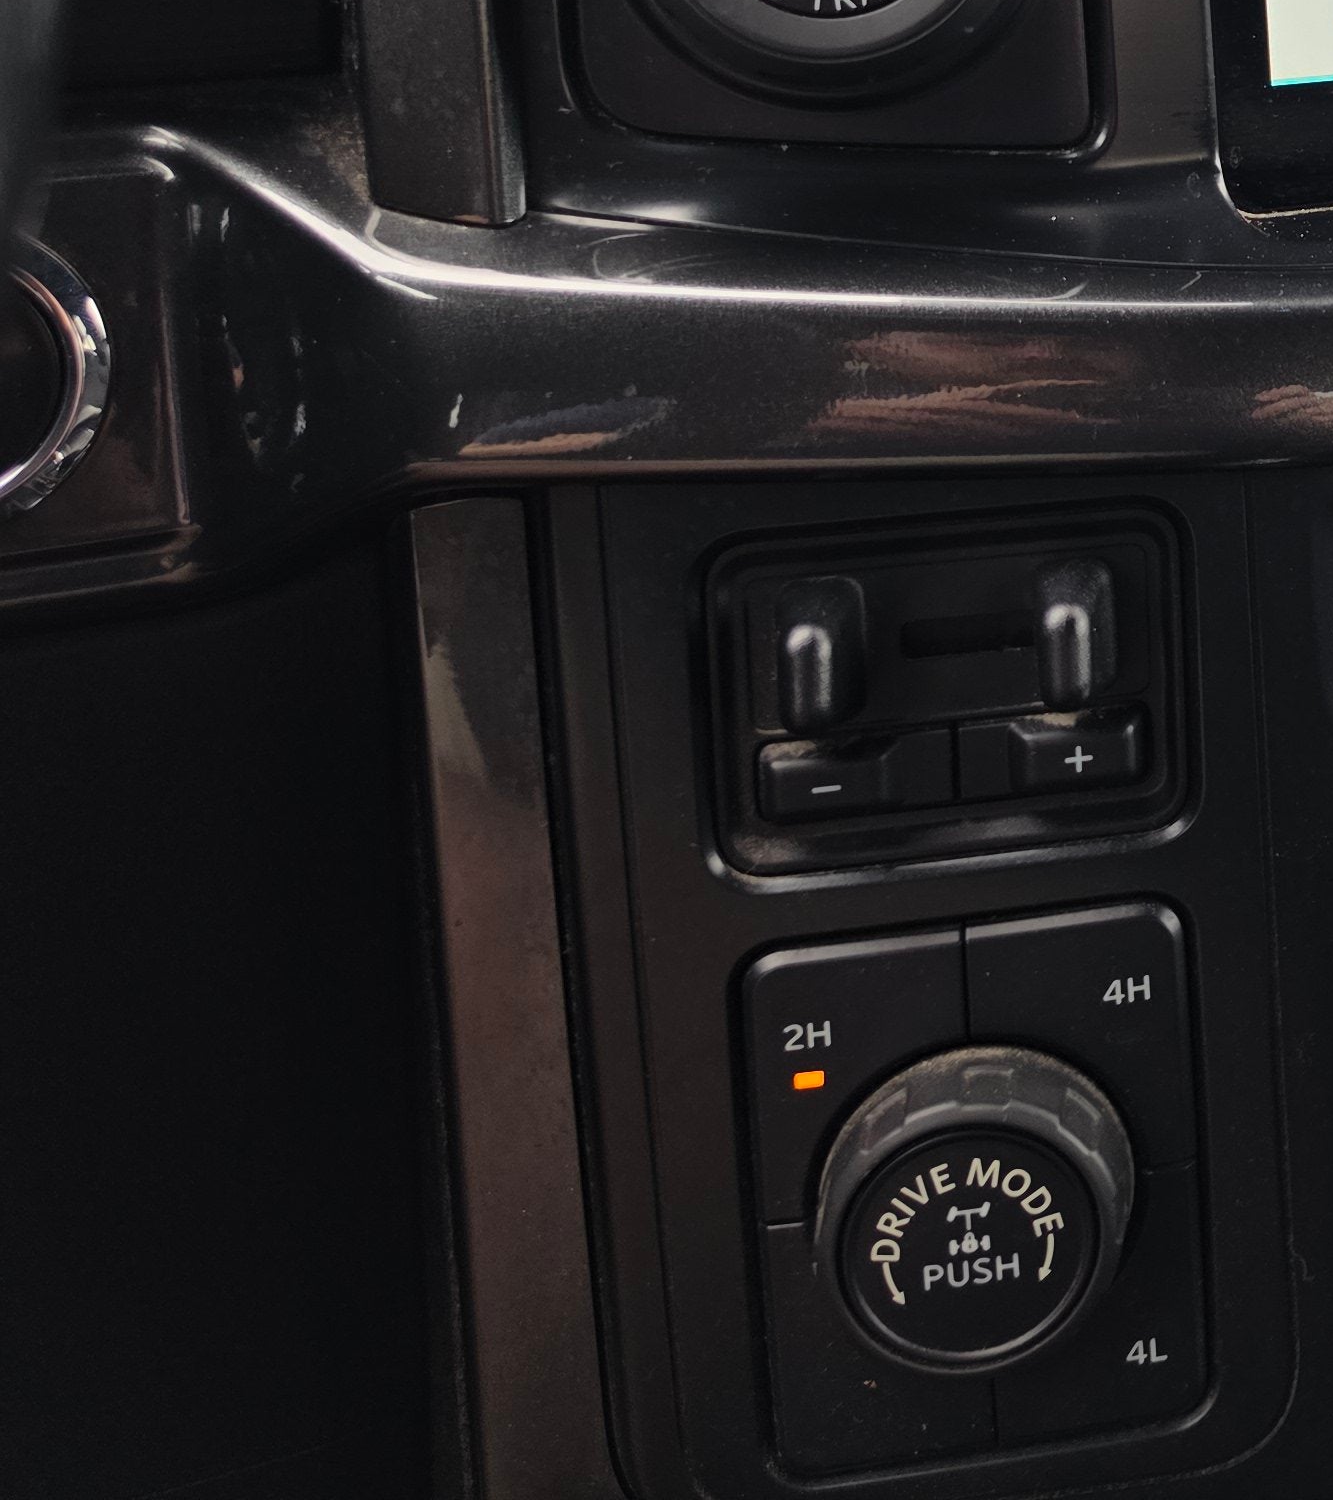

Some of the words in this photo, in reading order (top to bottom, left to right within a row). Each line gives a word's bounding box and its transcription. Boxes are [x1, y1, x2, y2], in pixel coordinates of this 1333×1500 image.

[1102, 975, 1152, 1005] 4H
[782, 1021, 832, 1052] 2H
[871, 1163, 956, 1263] DRIVE
[966, 1157, 1065, 1237] MODE
[922, 1253, 1021, 1291] PUSH
[1126, 1338, 1168, 1365] 4L
